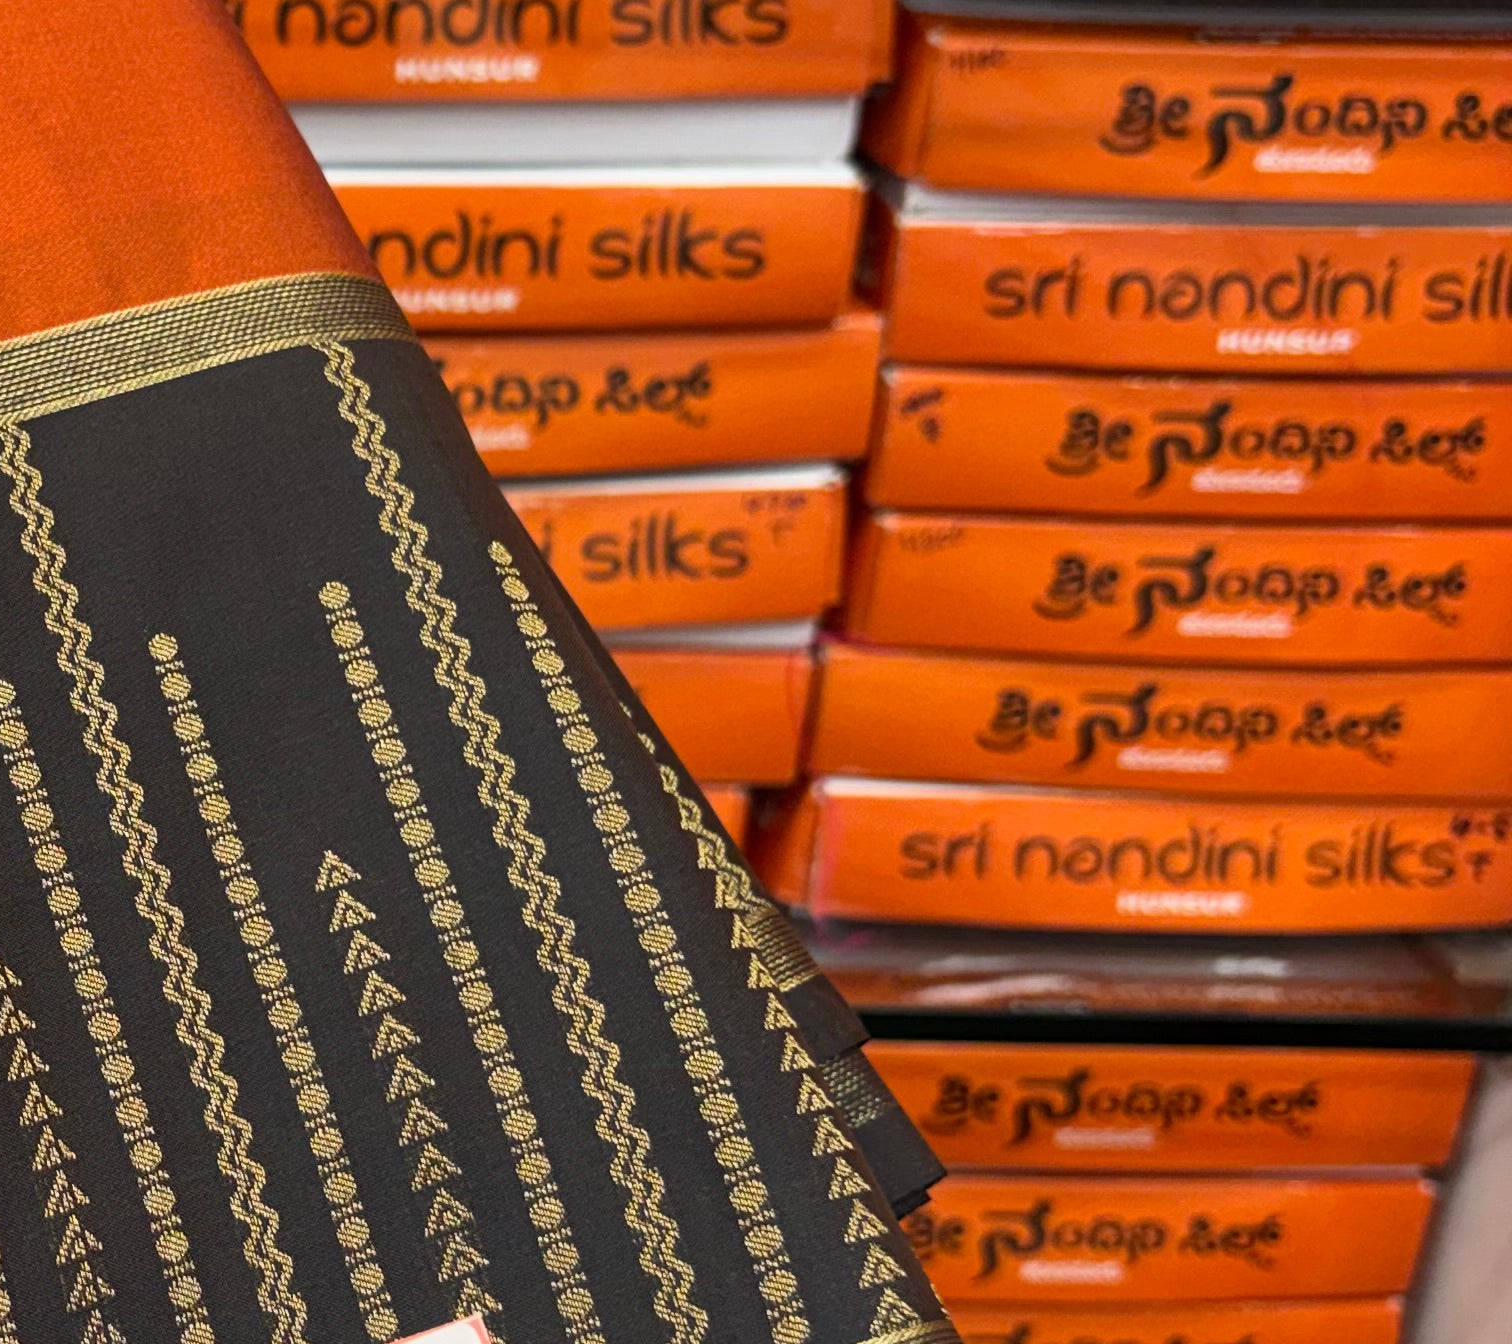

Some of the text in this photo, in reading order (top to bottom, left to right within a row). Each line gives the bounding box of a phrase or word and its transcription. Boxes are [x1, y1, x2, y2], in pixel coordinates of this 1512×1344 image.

[396, 56, 539, 82] HUNSUR
[1204, 72, 1429, 174] ನಂದಿನಿ
[370, 212, 767, 281] ndini silks
[985, 254, 1398, 321] sri nandini
[1142, 399, 1358, 494] ನಂದಿನಿ
[582, 516, 750, 582] silks
[900, 822, 989, 882] sri
[1013, 827, 1278, 885] nandini
[1307, 817, 1456, 887] silks
